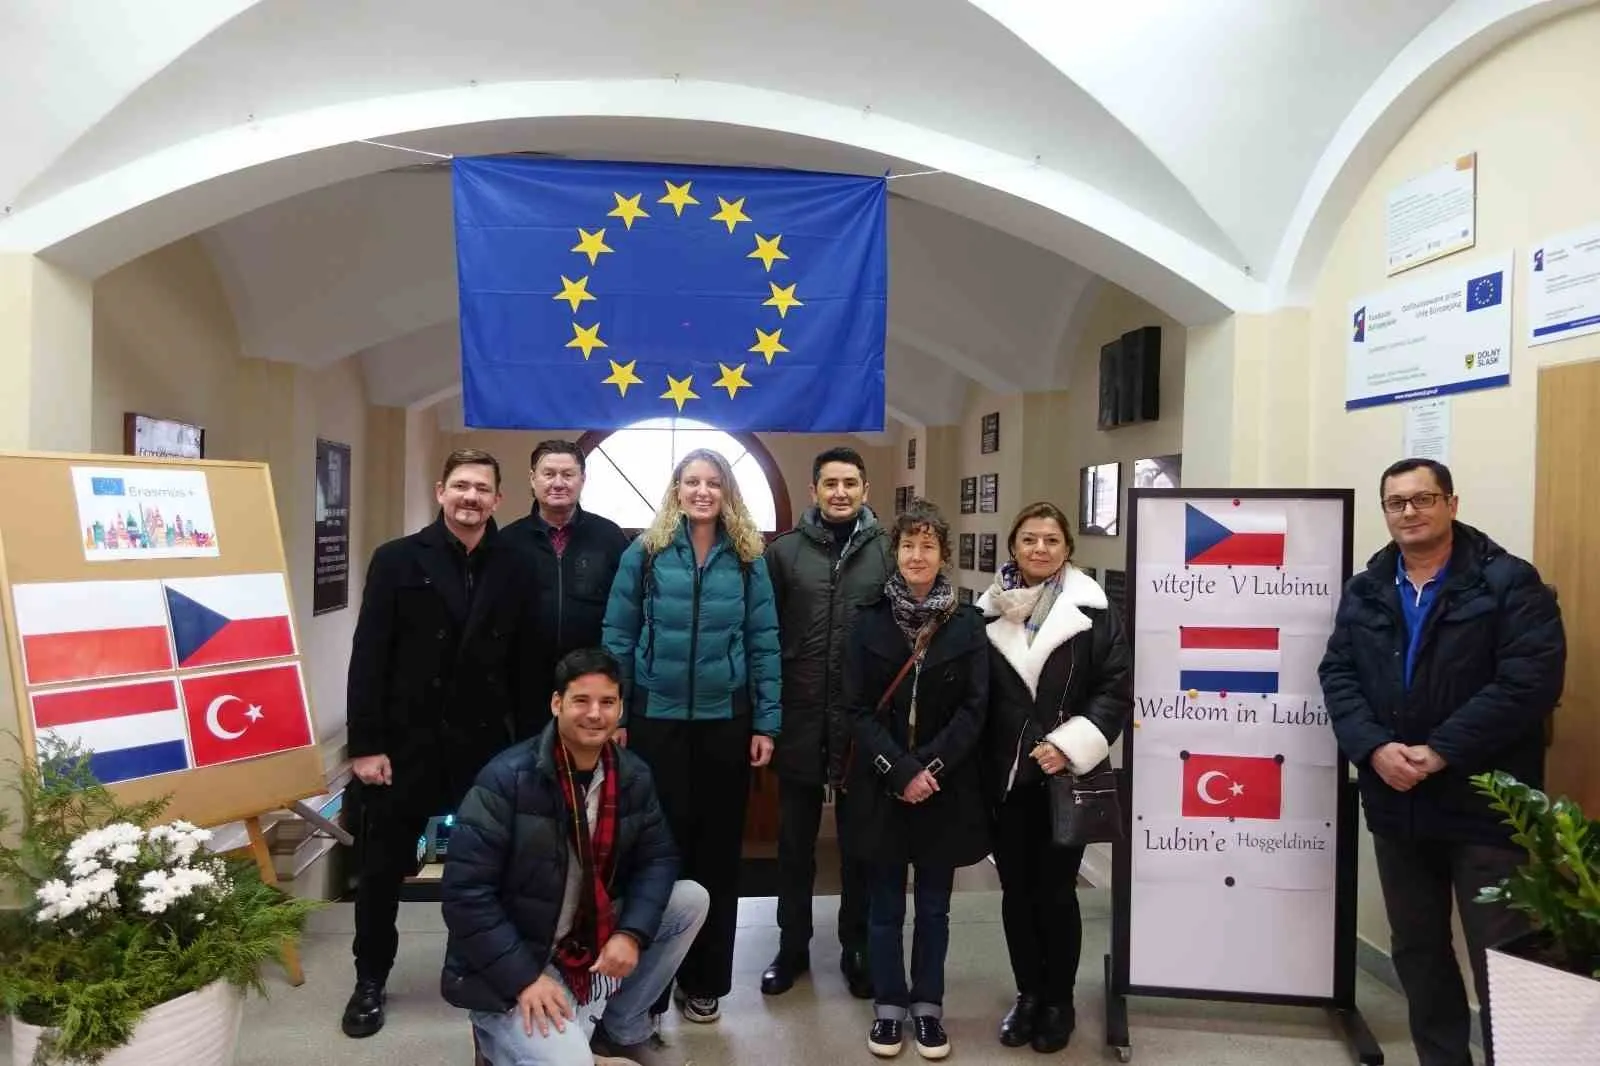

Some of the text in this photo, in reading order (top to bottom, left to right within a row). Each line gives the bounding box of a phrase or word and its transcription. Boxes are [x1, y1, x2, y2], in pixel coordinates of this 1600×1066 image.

[1477, 347, 1501, 360] DOLNY
[1152, 573, 1329, 601] vítejte V Lubinu
[1136, 696, 1228, 721] Welkom
[1237, 703, 1257, 723] in
[1144, 827, 1325, 853] Lubin'e Hoşgeldiniz
